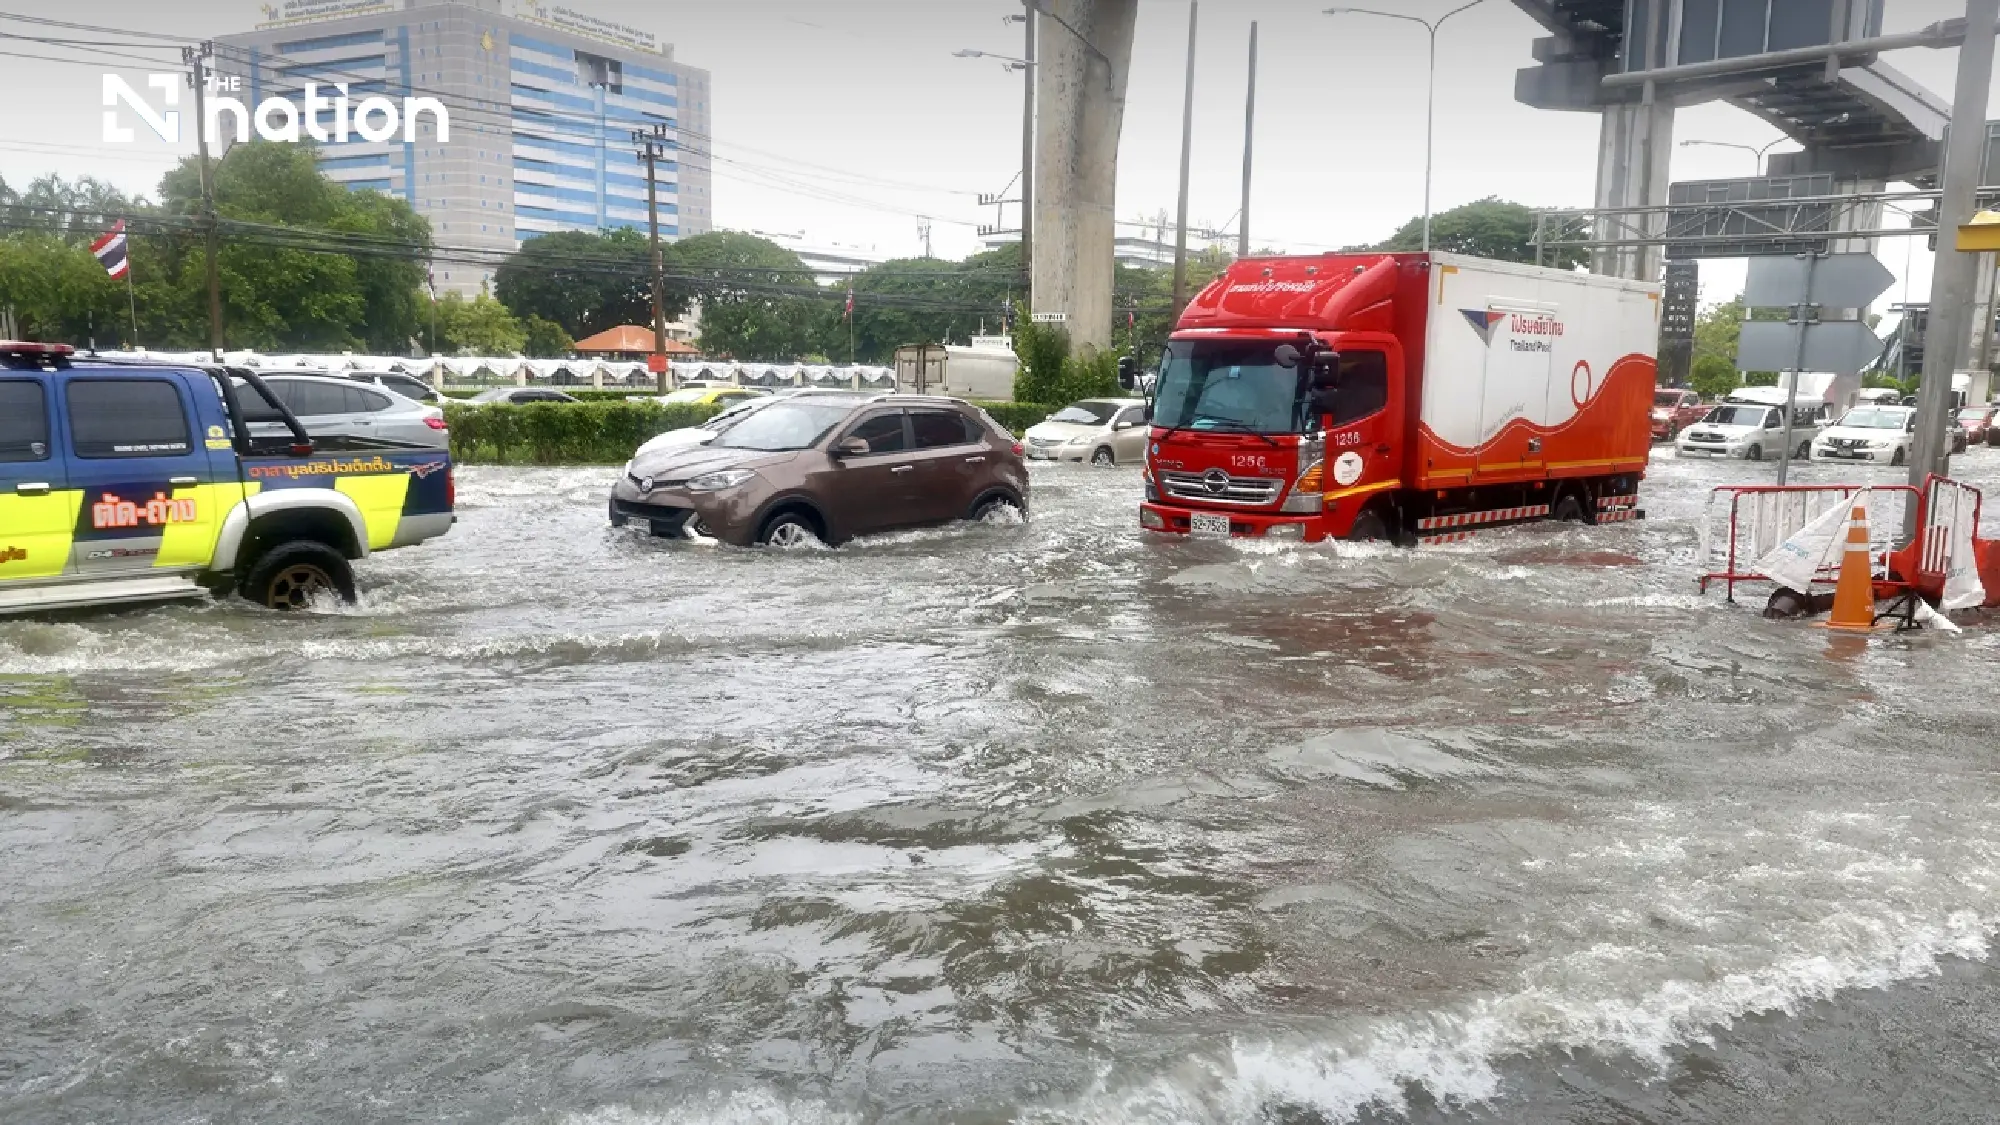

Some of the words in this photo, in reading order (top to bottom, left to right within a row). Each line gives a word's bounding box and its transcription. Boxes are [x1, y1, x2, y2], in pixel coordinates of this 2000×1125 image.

[1510, 339, 1536, 352] Thailand
[1537, 341, 1552, 352] Post
[1334, 431, 1361, 446] 1256
[1231, 455, 1266, 467] 1256
[92, 491, 197, 529] ตัด-ถ่าง
